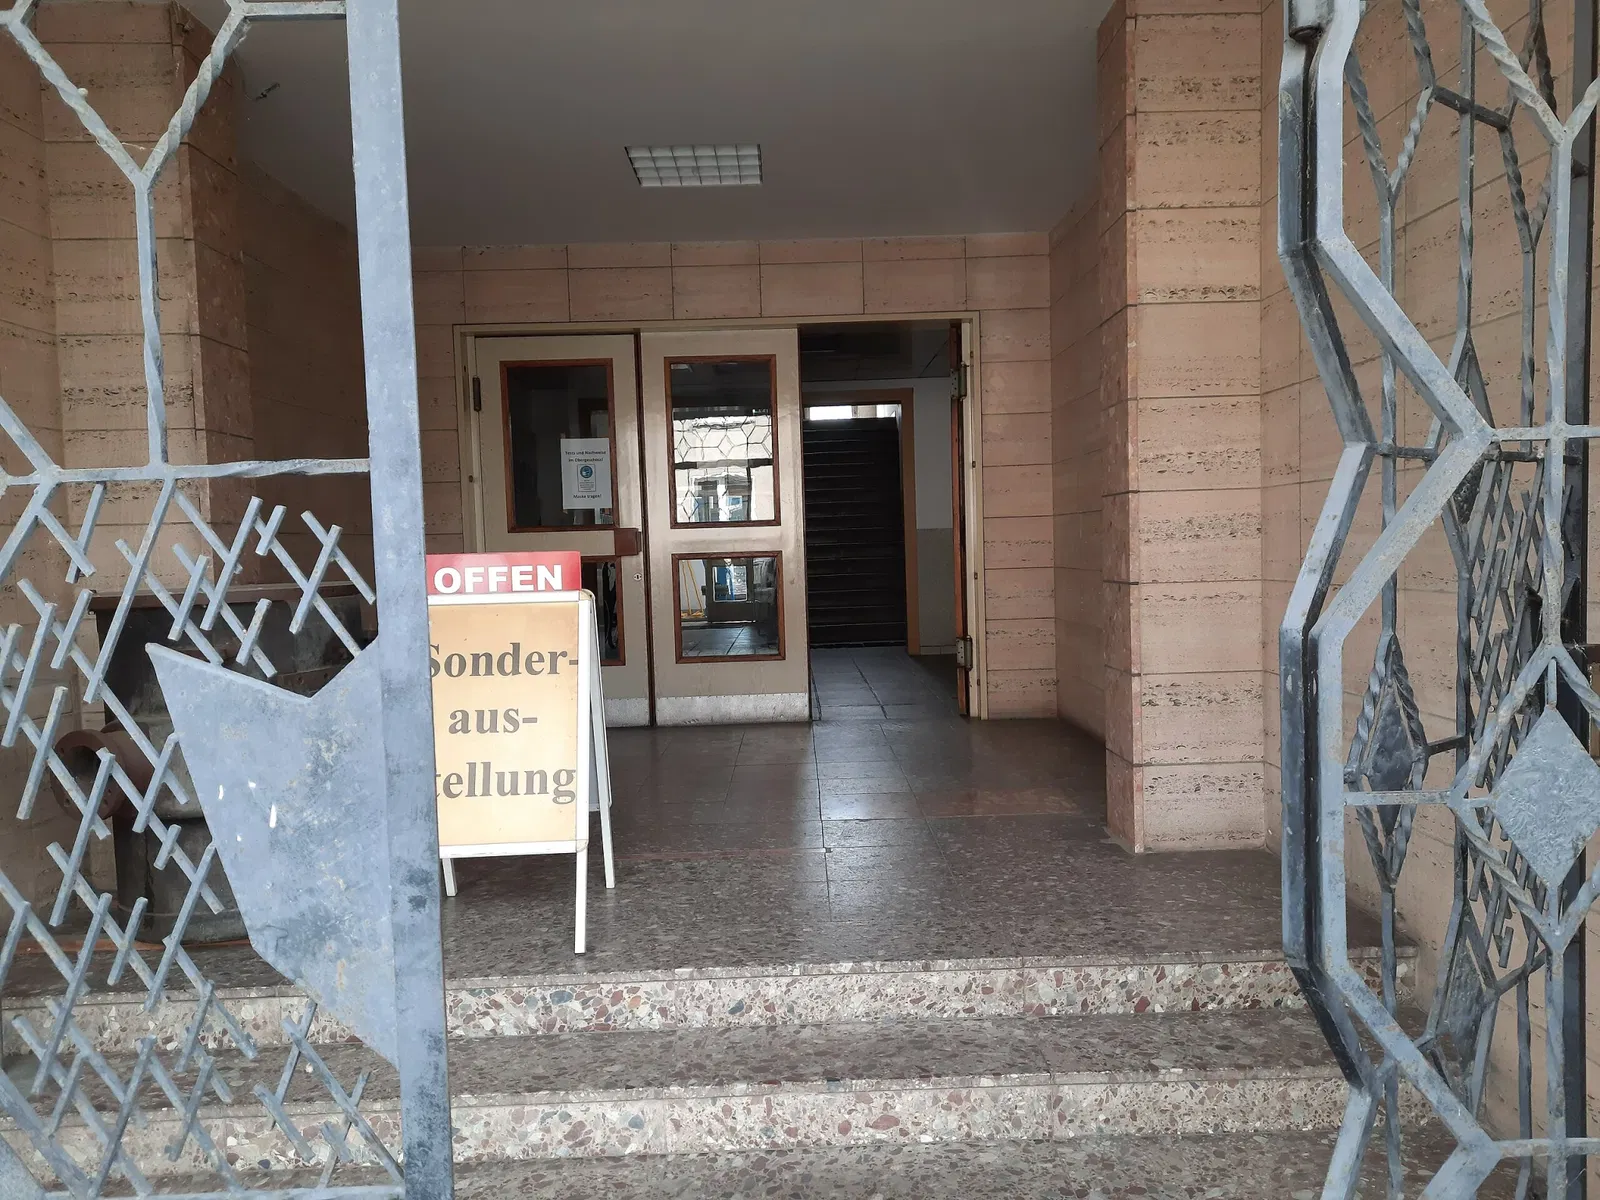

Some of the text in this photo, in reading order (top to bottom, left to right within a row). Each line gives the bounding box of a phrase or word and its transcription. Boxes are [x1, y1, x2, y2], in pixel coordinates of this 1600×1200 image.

[433, 564, 563, 594] OFFEN
[448, 708, 538, 735] aus-
[436, 761, 577, 805] ellung
